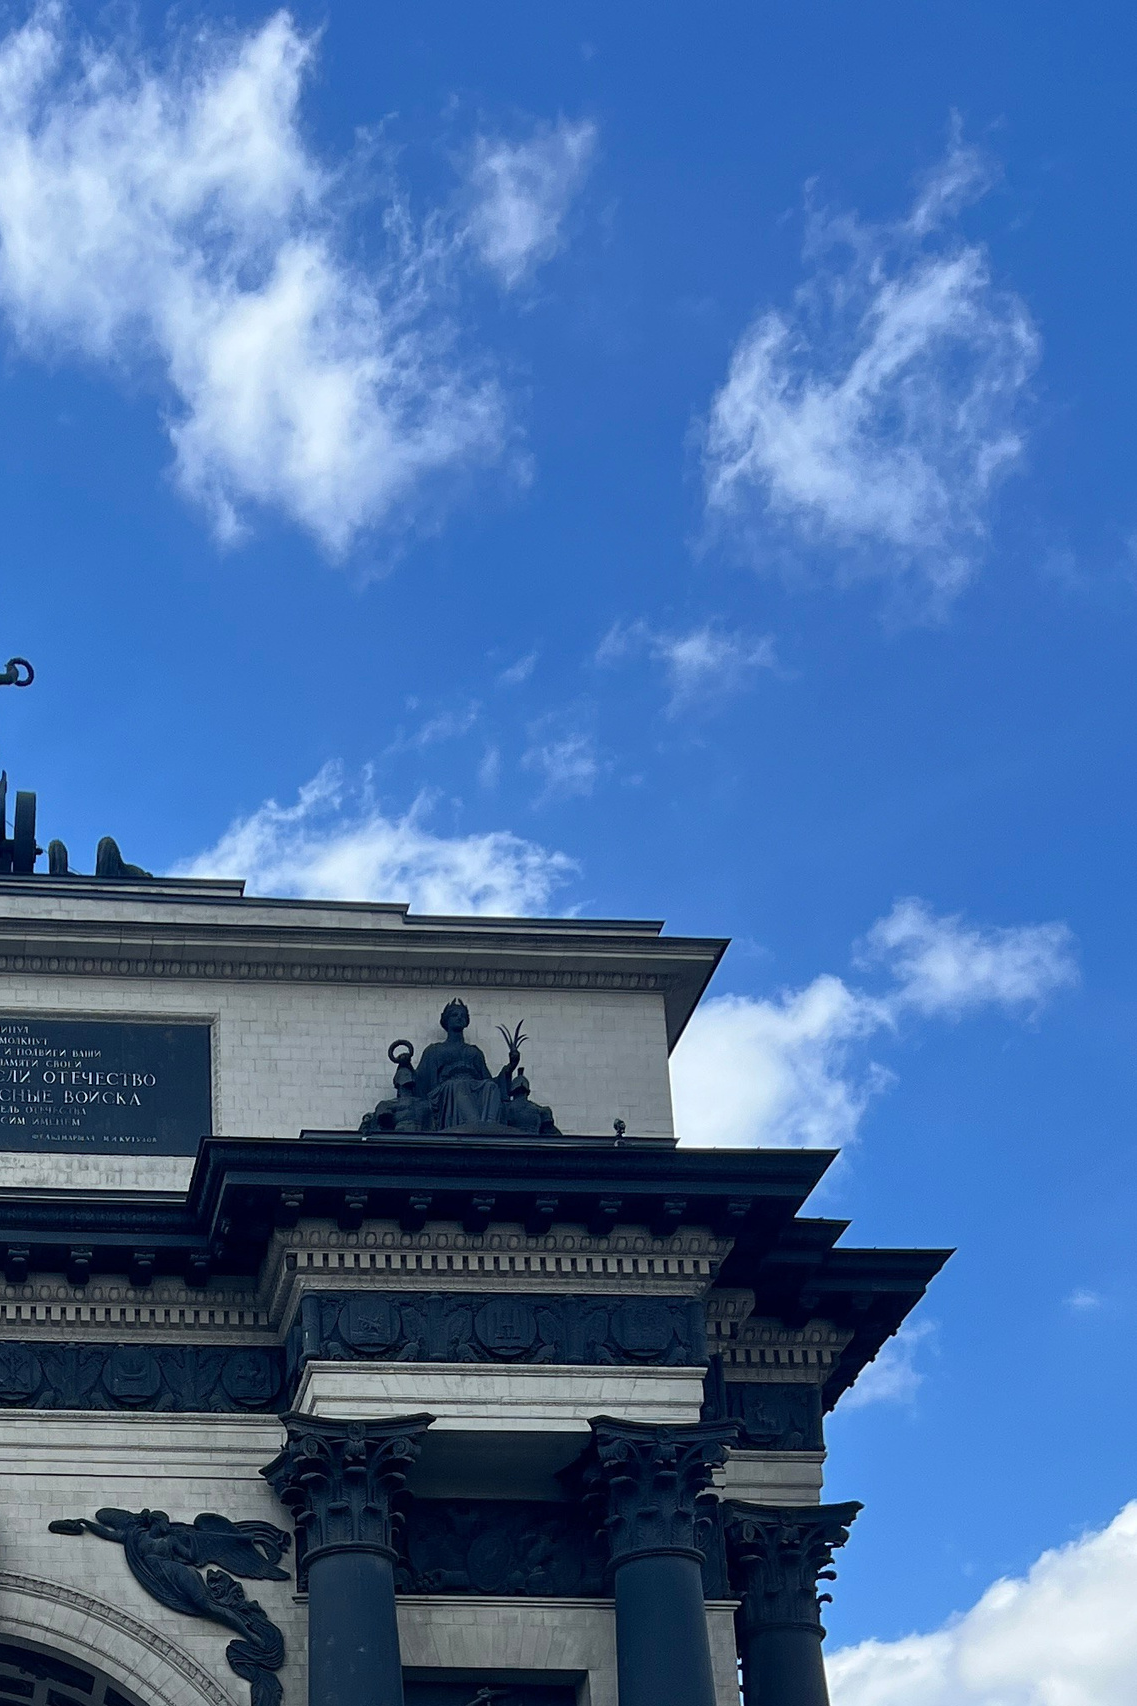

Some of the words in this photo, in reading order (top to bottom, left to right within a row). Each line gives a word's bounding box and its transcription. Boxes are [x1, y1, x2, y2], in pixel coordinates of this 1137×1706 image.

[72, 1050, 102, 1058] ВАШИ
[43, 1070, 157, 1087] ОТЕЧЕСТВО
[64, 1087, 142, 1106] ВОЙСКА
[1, 1116, 26, 1125] СИМ
